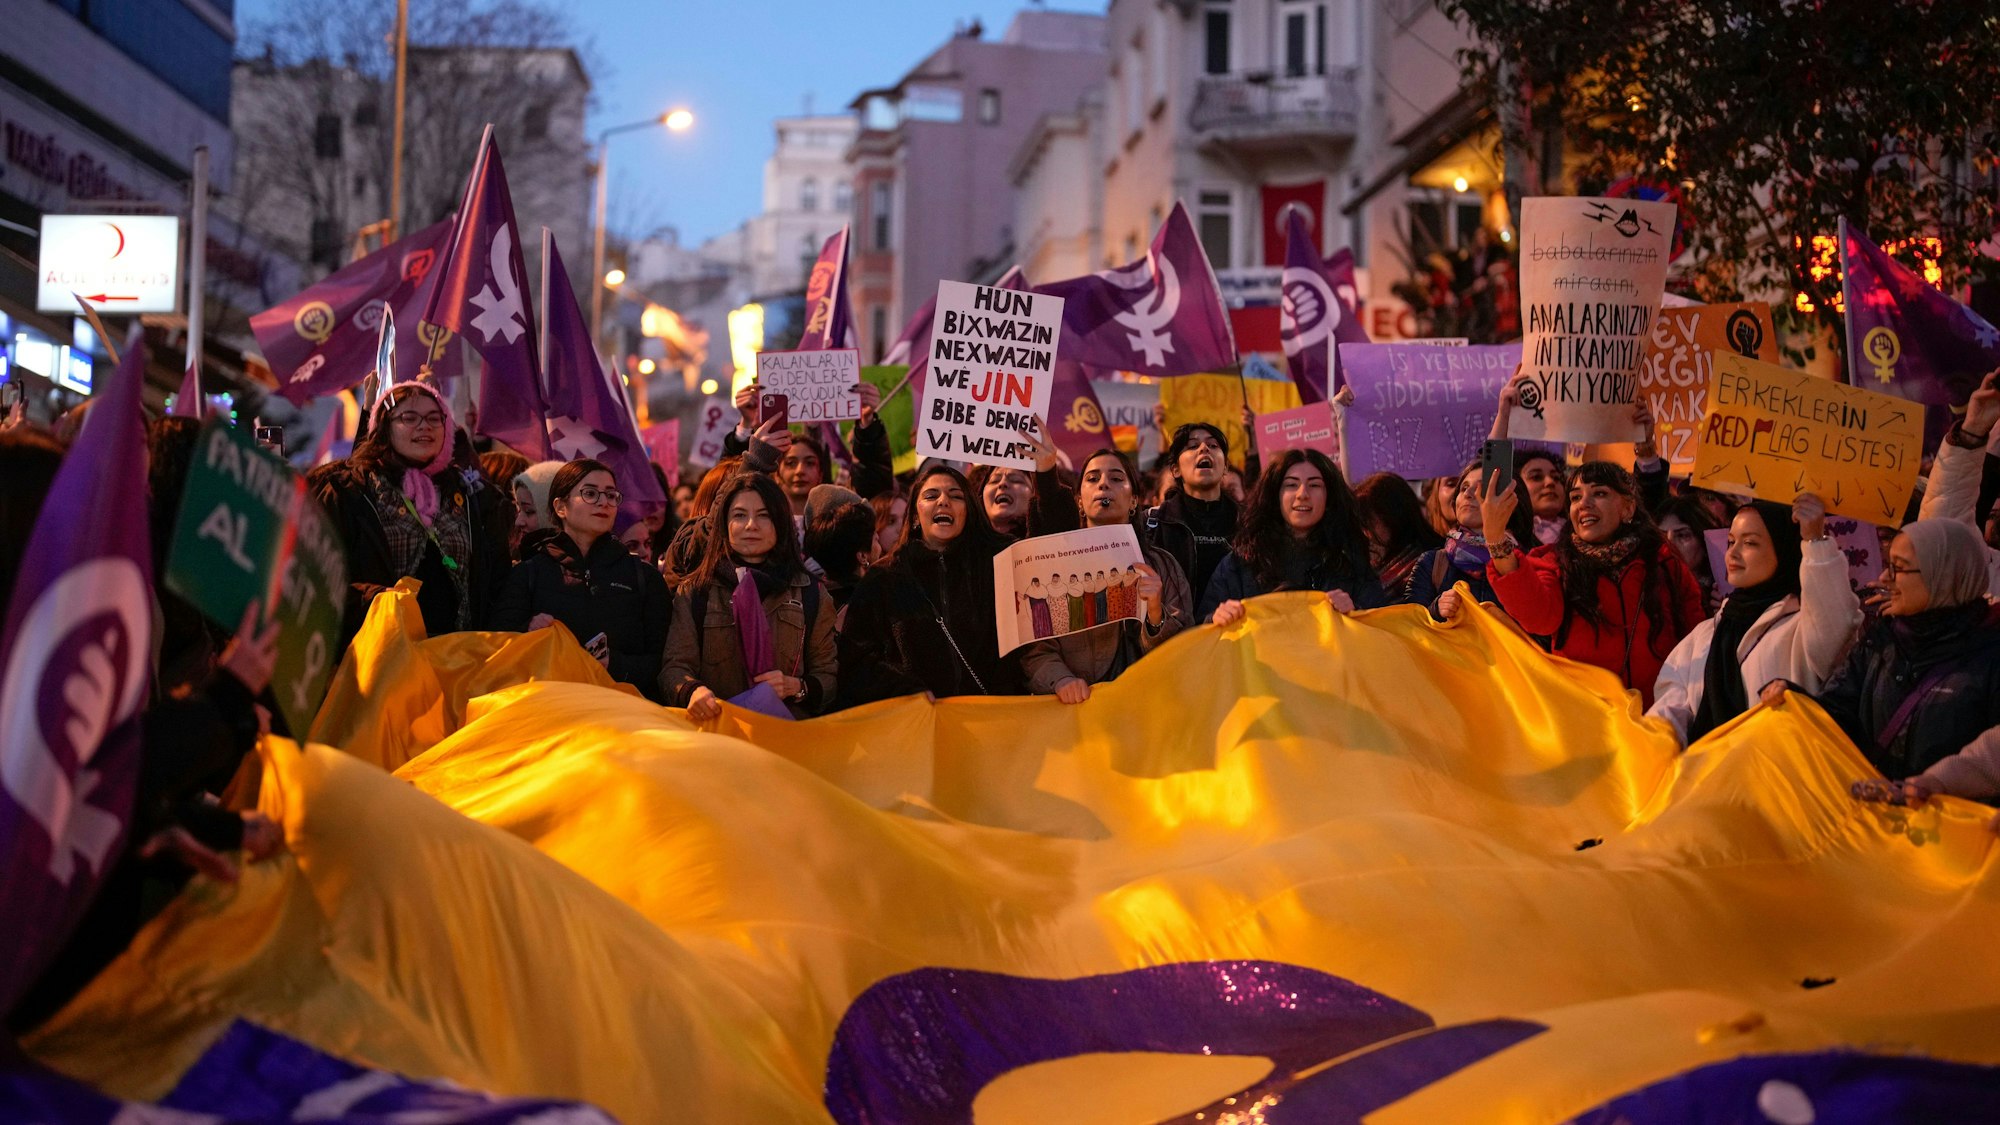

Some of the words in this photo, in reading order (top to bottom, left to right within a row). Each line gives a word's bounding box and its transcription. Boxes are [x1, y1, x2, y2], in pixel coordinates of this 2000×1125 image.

[943, 310, 1052, 345] BİXWAZİN
[1529, 302, 1653, 337] ANALARINIZIN
[761, 353, 854, 370] KALANLARIN
[935, 338, 1051, 372] NEXWAZİN
[971, 369, 1033, 409] JİN
[1538, 369, 1636, 404] YIKIYORUZ
[1718, 372, 1867, 431] ERKEKLERİN
[788, 400, 859, 419] CADELE
[962, 434, 1037, 460] WELAT
[1705, 412, 1749, 448] RED
[1820, 432, 1904, 472] LİSTESİ
[1014, 560, 1023, 568] jin
[1111, 540, 1120, 548] de
